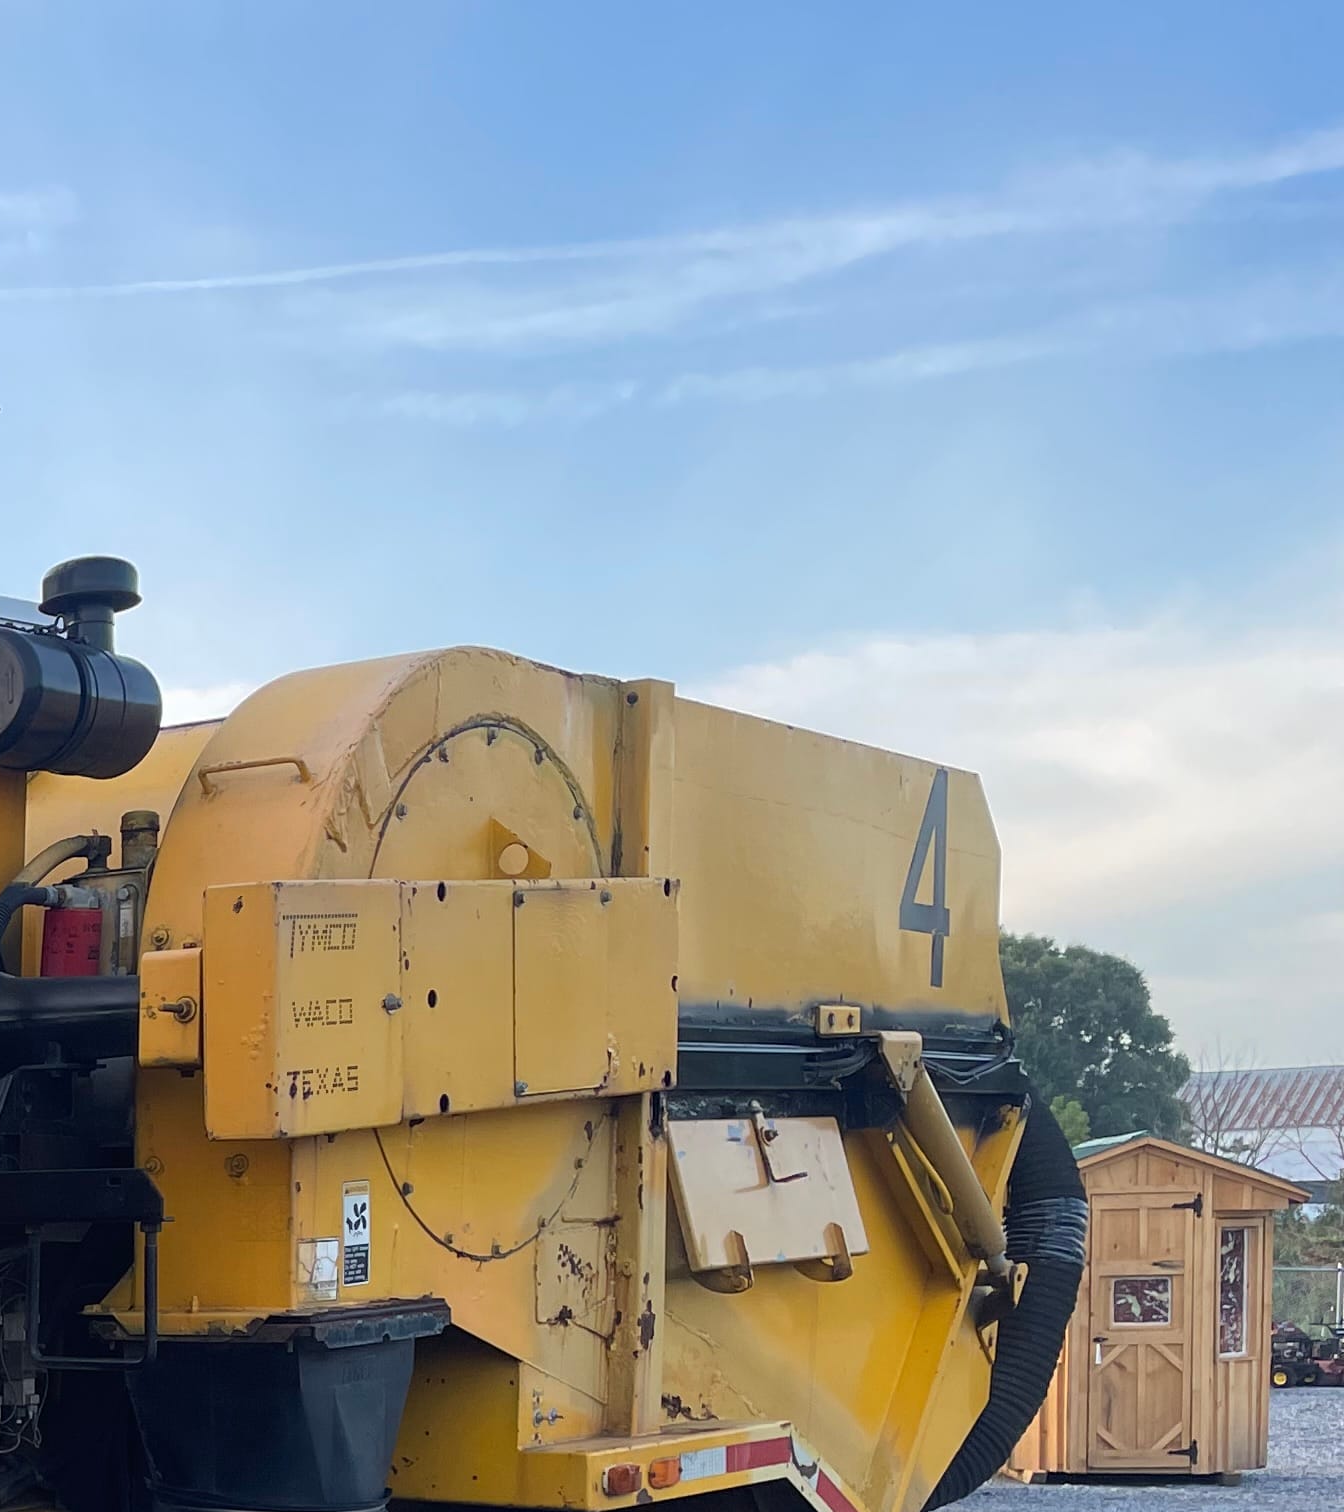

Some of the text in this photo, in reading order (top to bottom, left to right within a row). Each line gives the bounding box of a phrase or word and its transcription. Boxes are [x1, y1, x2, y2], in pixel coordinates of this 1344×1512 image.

[899, 768, 951, 988] 4
[282, 913, 358, 958] TYMCO
[291, 998, 353, 1028] WACO
[286, 1065, 359, 1100] TEXAS
